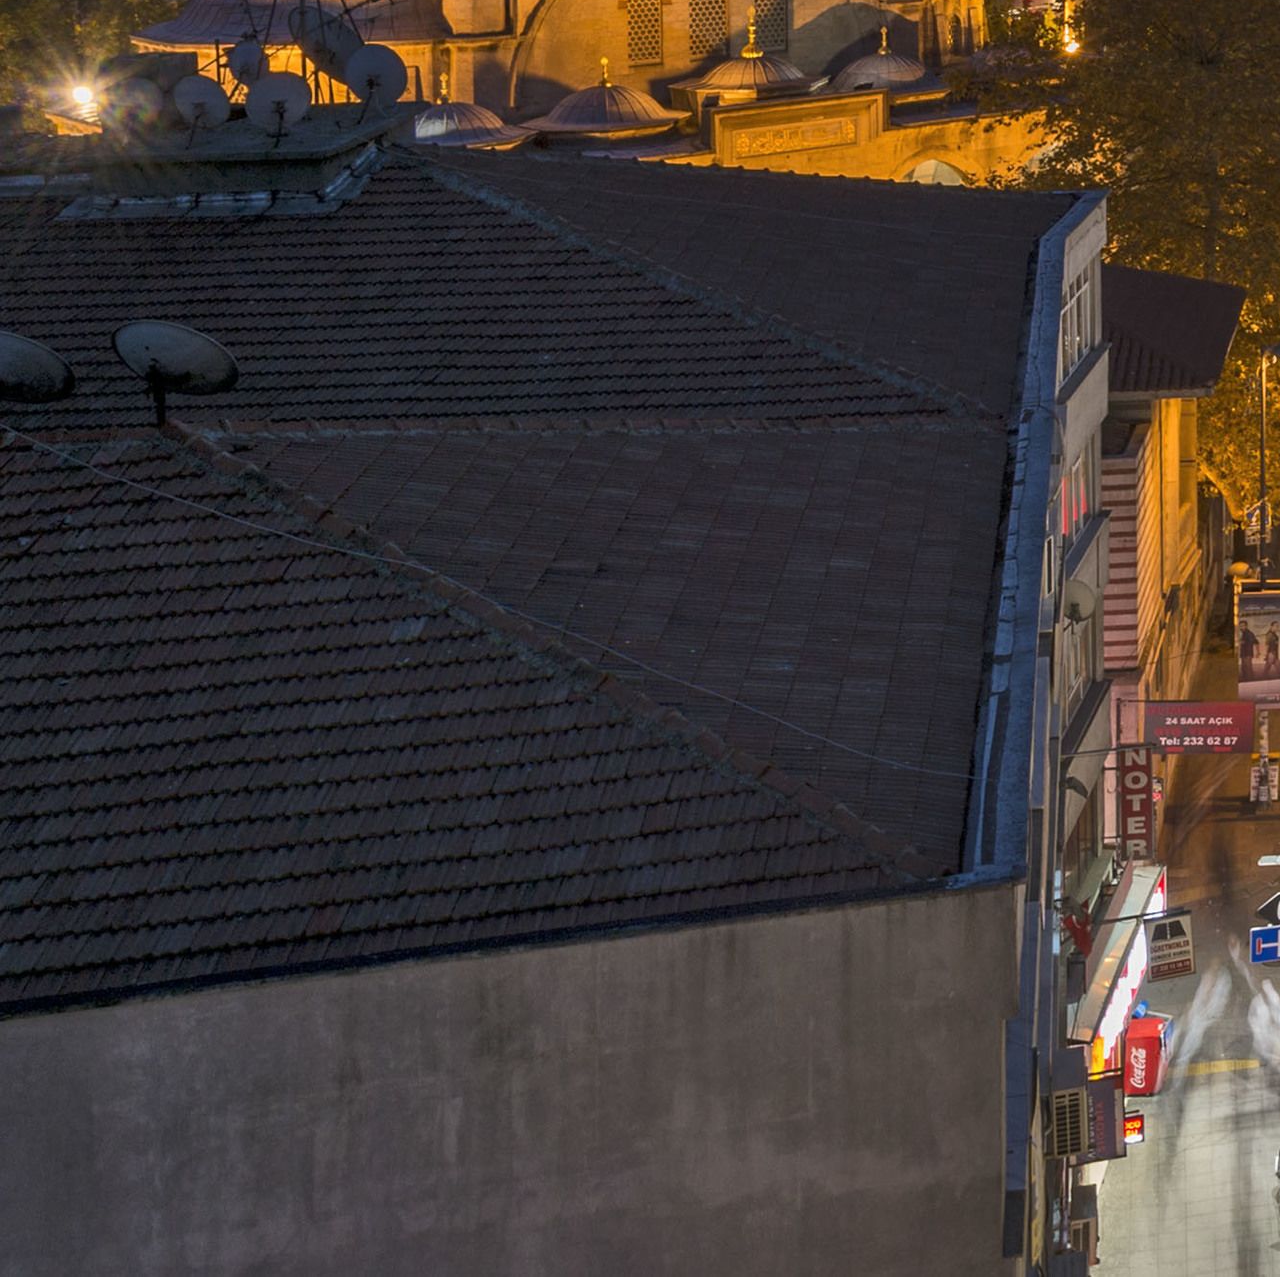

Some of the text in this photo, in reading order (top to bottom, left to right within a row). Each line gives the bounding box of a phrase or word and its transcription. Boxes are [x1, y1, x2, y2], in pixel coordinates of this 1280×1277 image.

[1165, 717, 1233, 726] 24 SAAT AÇIK
[1160, 736, 1238, 746] Tel: 232 62 87
[1124, 748, 1148, 856] NOTER
